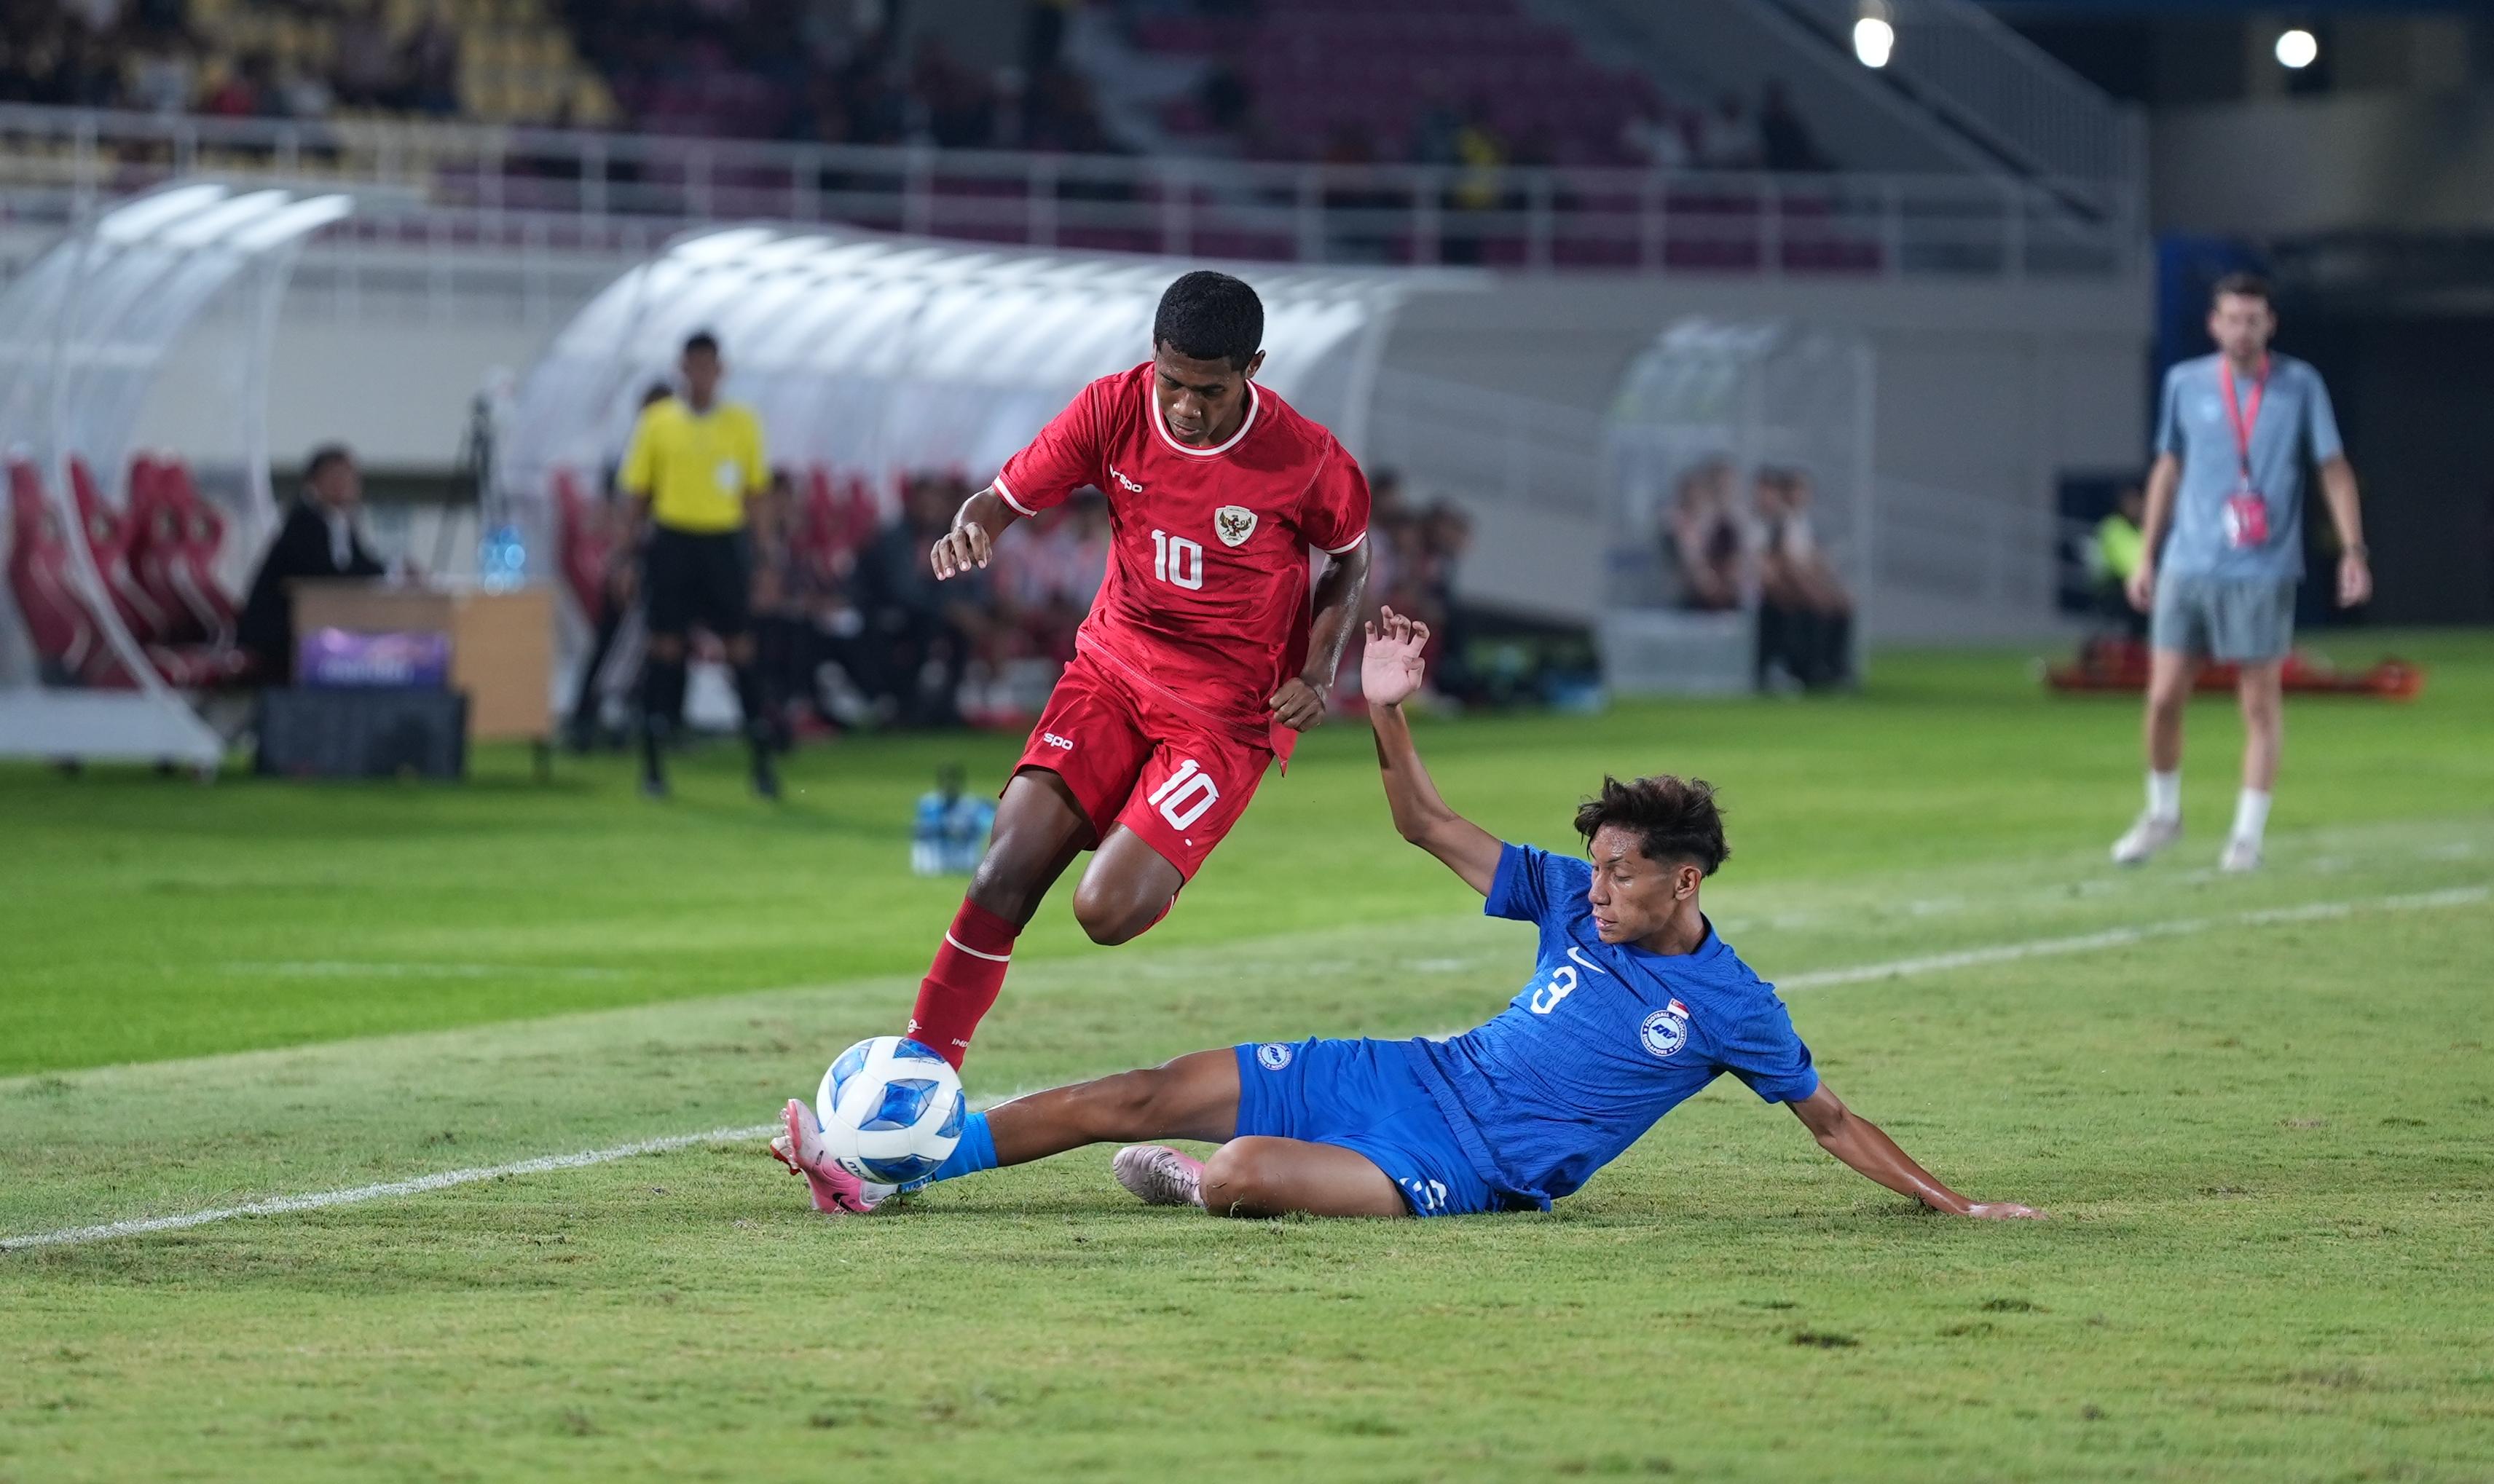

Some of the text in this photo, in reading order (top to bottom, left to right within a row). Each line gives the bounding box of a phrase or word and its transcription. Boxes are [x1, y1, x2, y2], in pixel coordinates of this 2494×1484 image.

[1151, 529, 1203, 591] 10
[1147, 758, 1219, 831] 10
[1530, 965, 1578, 1015] 3
[1643, 1033, 1668, 1054] SINGAPORE
[1645, 1011, 1685, 1050] FOOTBALL ASSOCIATION
